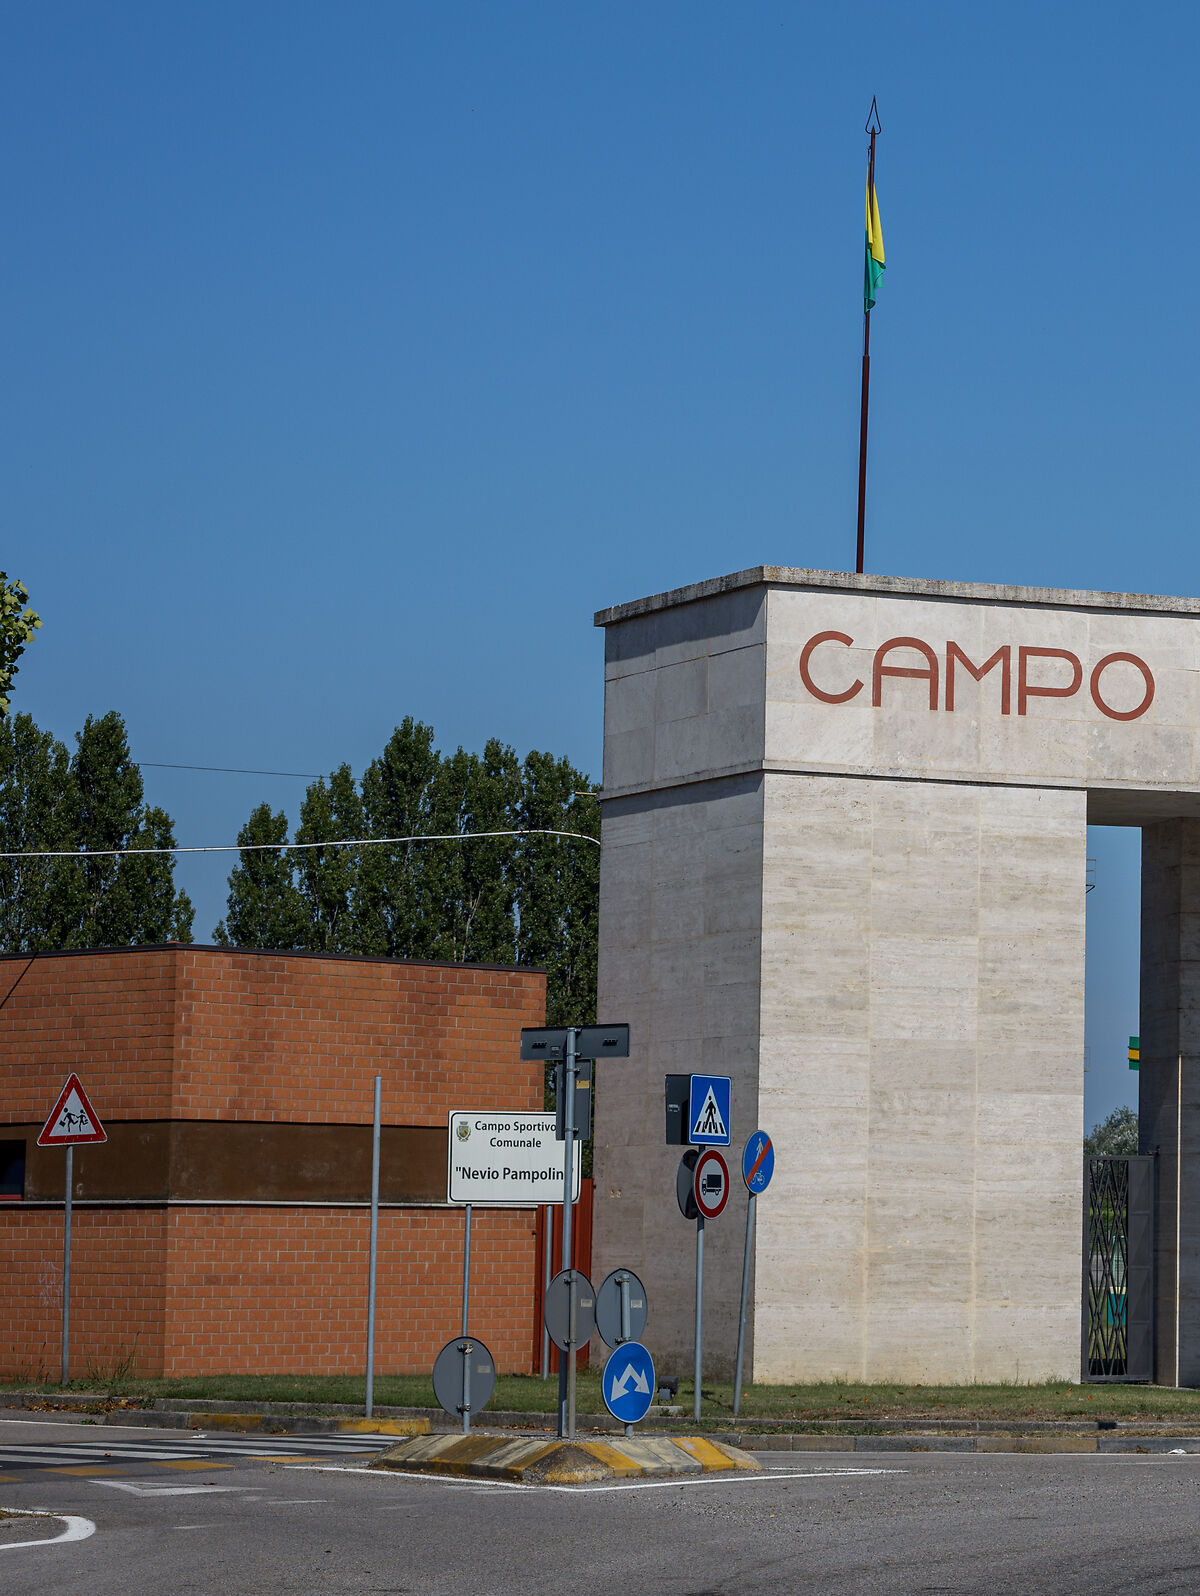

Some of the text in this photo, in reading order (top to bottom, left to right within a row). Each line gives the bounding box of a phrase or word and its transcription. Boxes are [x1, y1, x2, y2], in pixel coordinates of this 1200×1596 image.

[799, 630, 1155, 721] CAMPO
[474, 1120, 556, 1134] Campo Sportivo
[489, 1137, 542, 1148] Comunale
[455, 1166, 499, 1180] "Nevio
